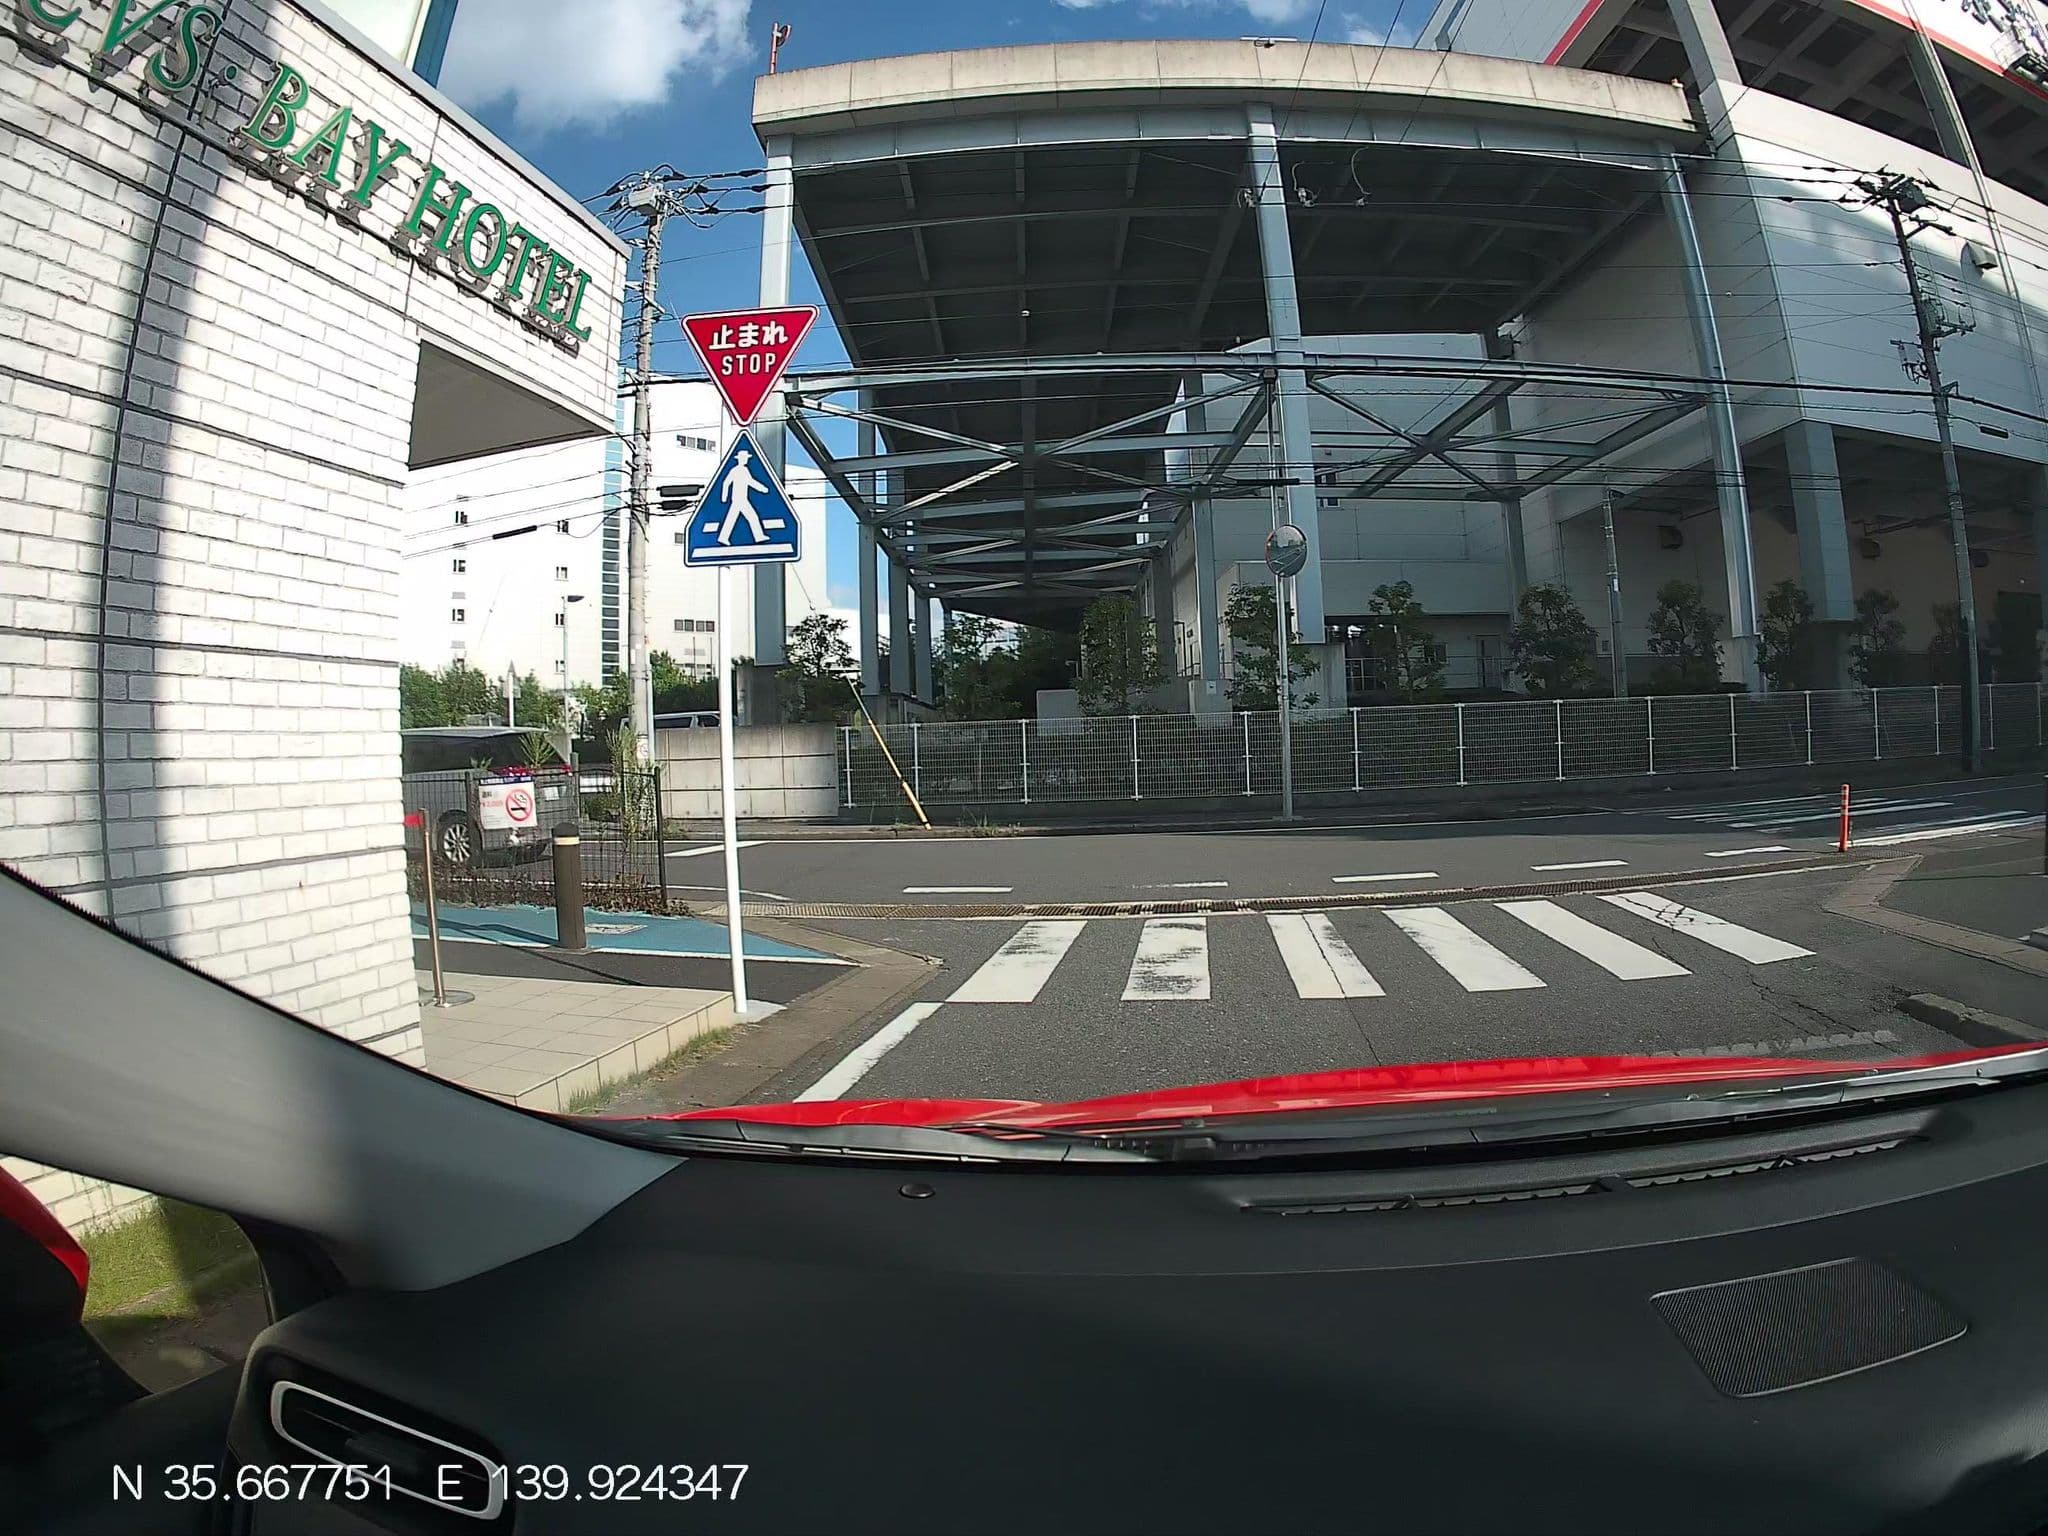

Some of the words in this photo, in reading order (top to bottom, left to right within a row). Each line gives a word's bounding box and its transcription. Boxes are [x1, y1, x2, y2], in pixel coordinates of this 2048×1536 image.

[240, 60, 412, 207] BAY
[401, 161, 593, 343] HOTEL
[708, 320, 789, 350] 止まれ
[721, 352, 777, 376] STOP
